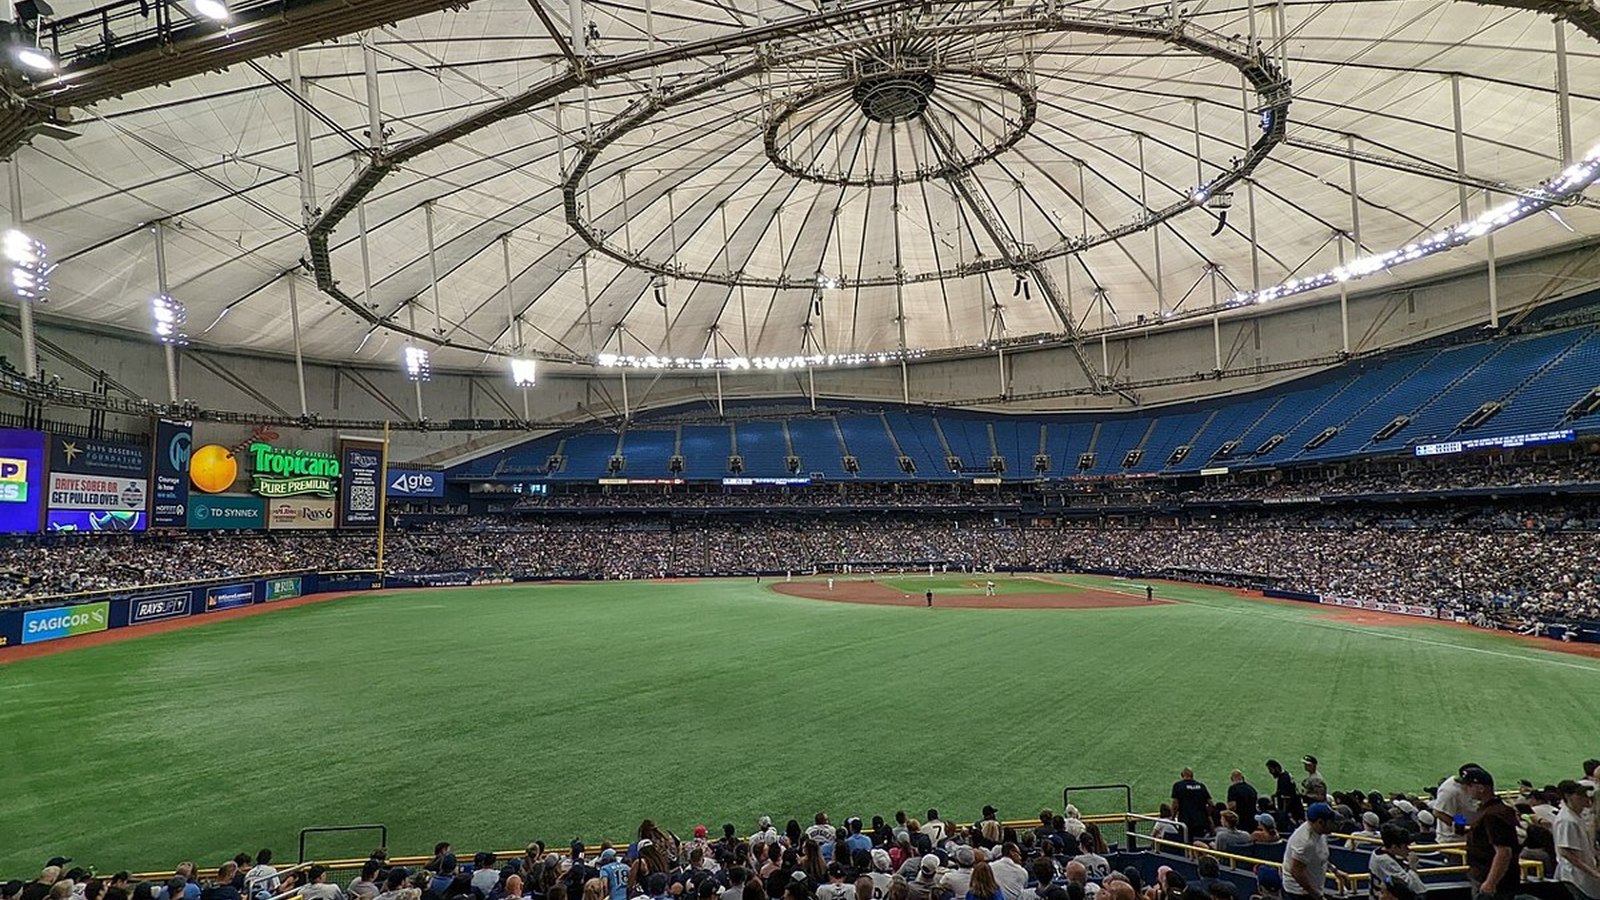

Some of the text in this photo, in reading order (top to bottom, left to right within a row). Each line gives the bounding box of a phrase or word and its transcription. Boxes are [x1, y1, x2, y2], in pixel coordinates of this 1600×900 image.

[86, 444, 105, 452] RAYS
[86, 452, 142, 465] FOUNDATION
[250, 443, 339, 477] Tropicana
[55, 478, 118, 492] DRIVE SOBER OR
[260, 480, 329, 493] PURE PREMIUM
[408, 474, 432, 489] gte
[52, 492, 68, 503] GET
[69, 493, 99, 504] PULLED
[100, 494, 119, 505] OVER
[210, 508, 258, 518] TD SYNNEX
[325, 507, 333, 519] 6
[28, 613, 89, 633] SAGICOR
[932, 825, 942, 840] 7
[614, 870, 629, 886] 18
